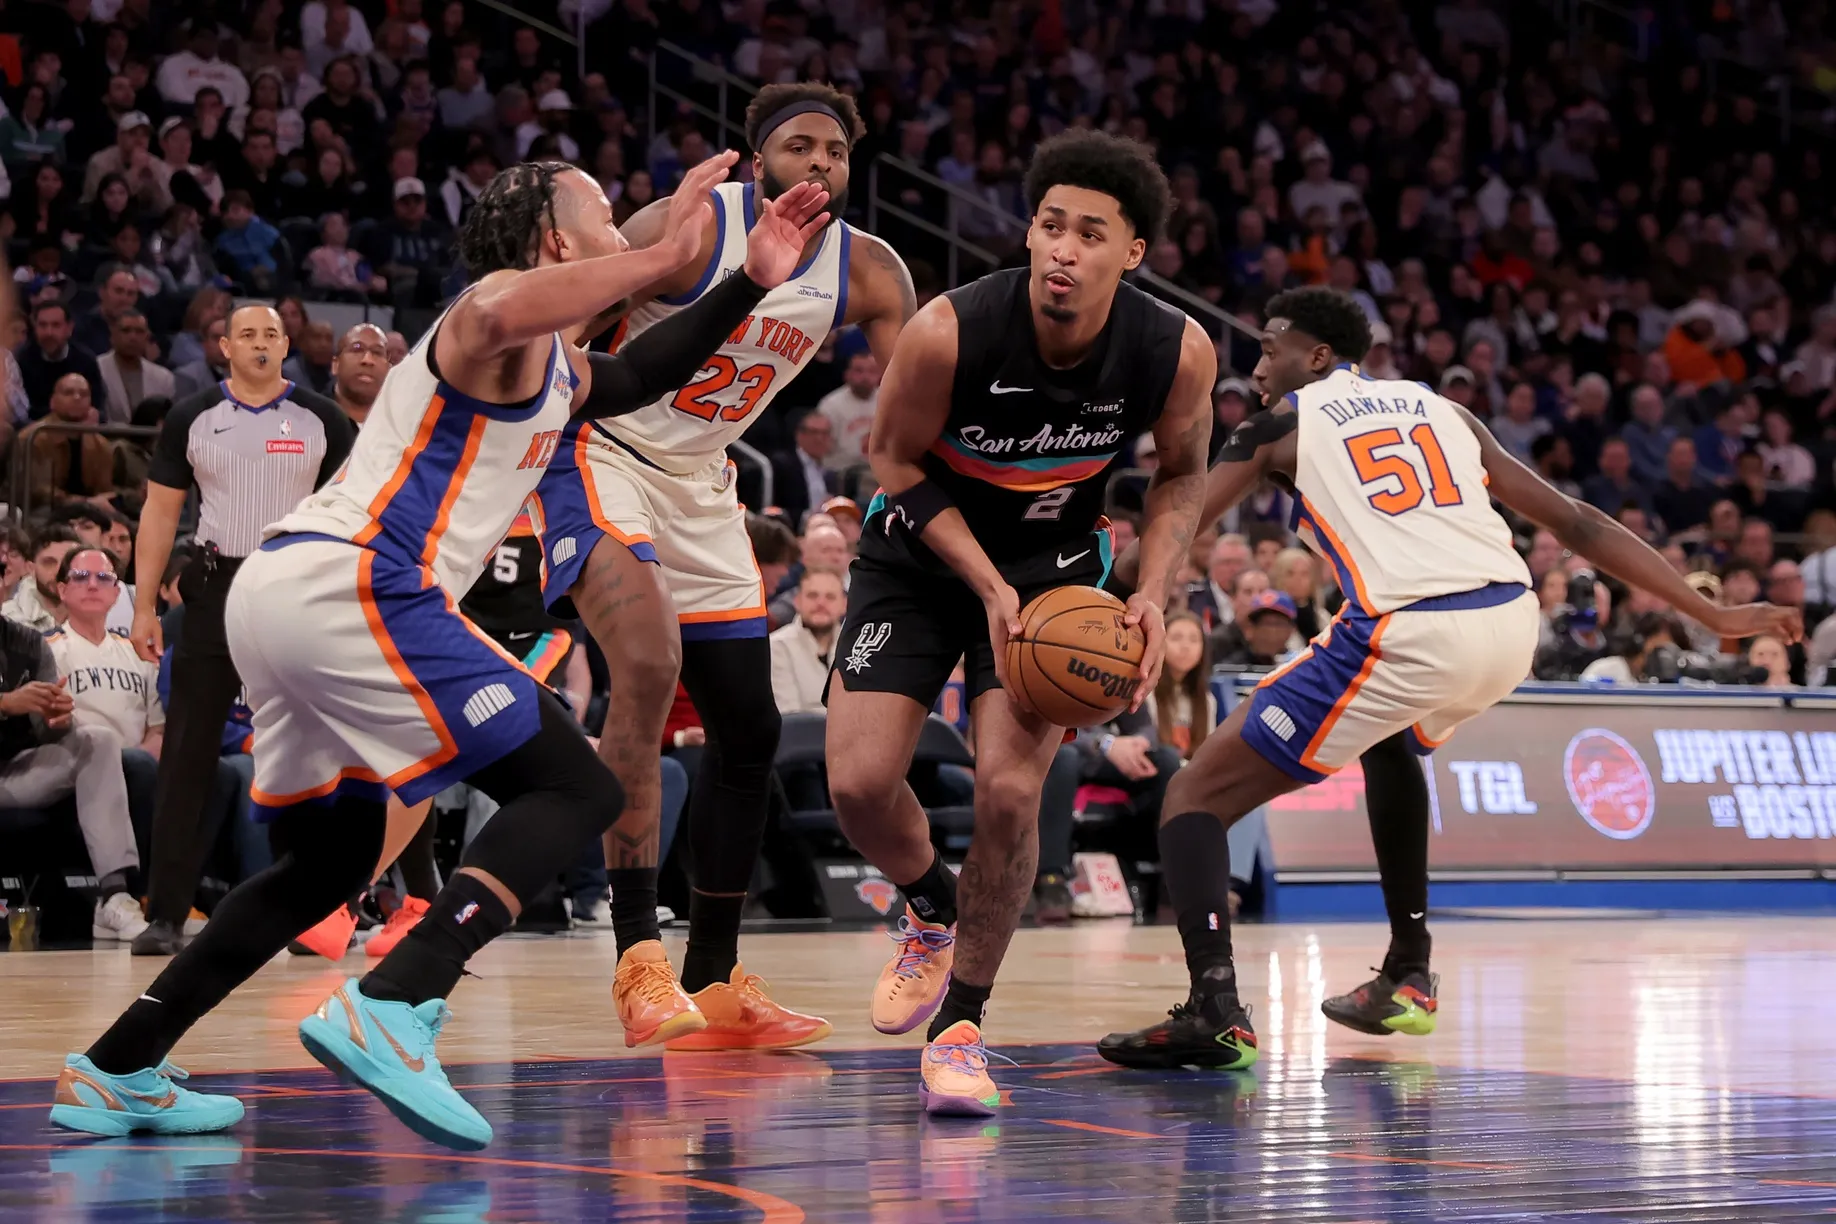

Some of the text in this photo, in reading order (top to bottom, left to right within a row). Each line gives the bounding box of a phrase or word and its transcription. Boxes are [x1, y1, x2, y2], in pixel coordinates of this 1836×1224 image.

[797, 289, 833, 300] abu dhabi
[670, 353, 777, 423] 23
[1087, 403, 1119, 412] LEDGER
[1319, 397, 1427, 426] DIAWARA
[267, 442, 304, 452] Emirates
[959, 422, 1124, 454] San Antonio
[1343, 423, 1463, 517] 51
[1021, 486, 1076, 521] 2
[493, 545, 521, 584] 5
[1653, 729, 1801, 783] JUPITER
[1448, 760, 1538, 814] TGL
